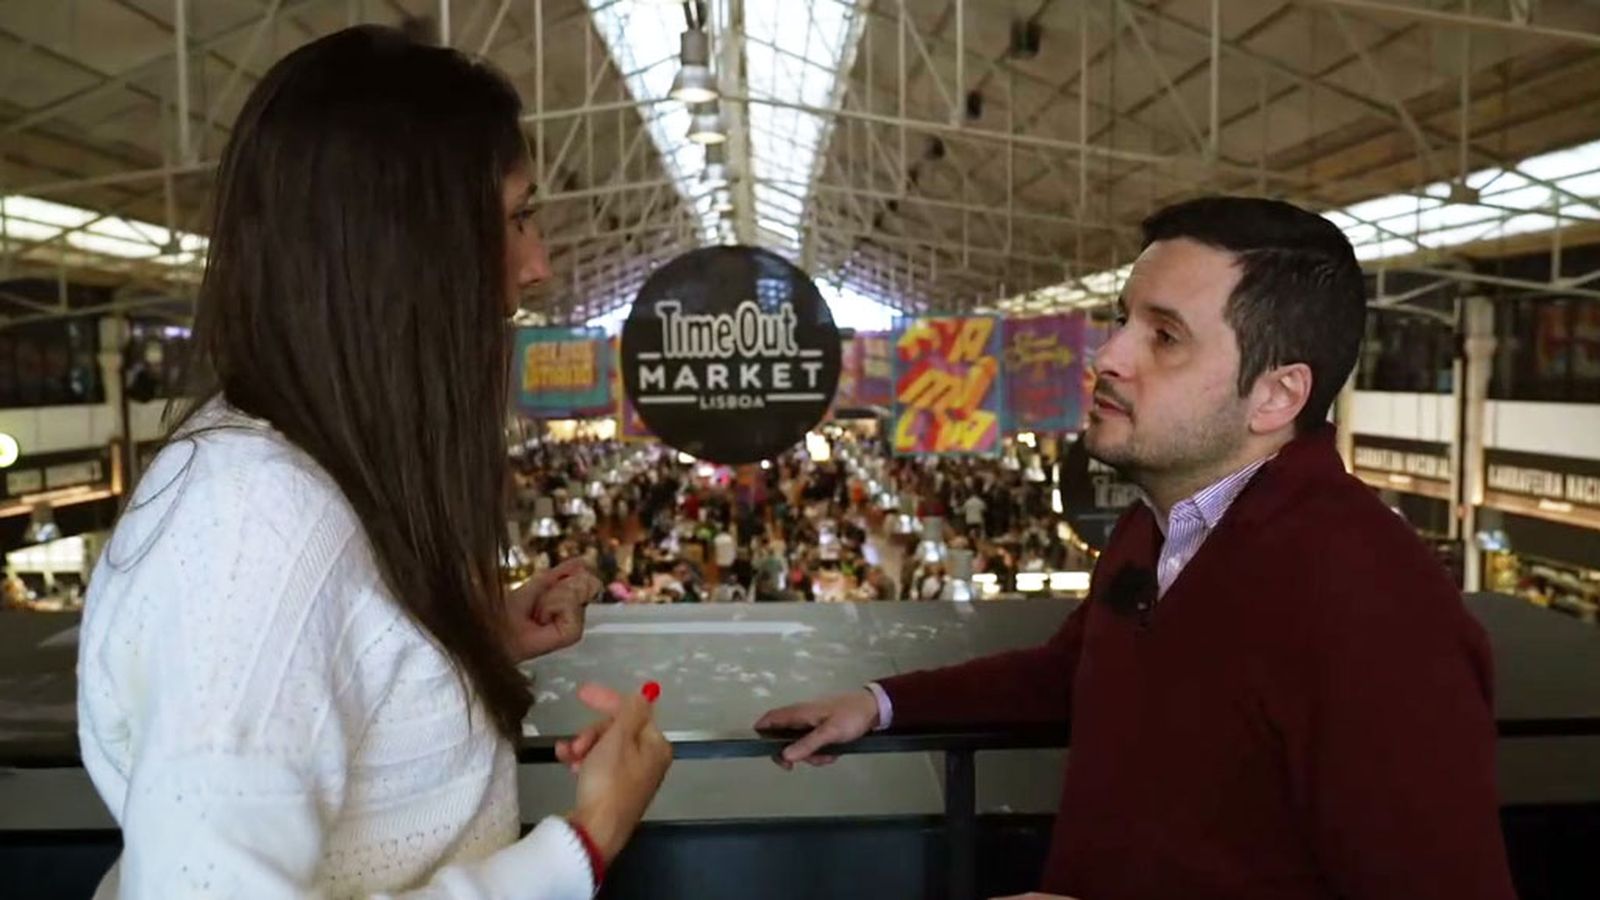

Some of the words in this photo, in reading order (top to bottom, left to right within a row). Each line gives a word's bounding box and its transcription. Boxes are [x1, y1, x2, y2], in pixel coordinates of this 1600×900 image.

[655, 301, 733, 358] Time
[735, 301, 798, 358] Out
[638, 362, 823, 390] MARKET
[700, 394, 765, 410] LISBOA
